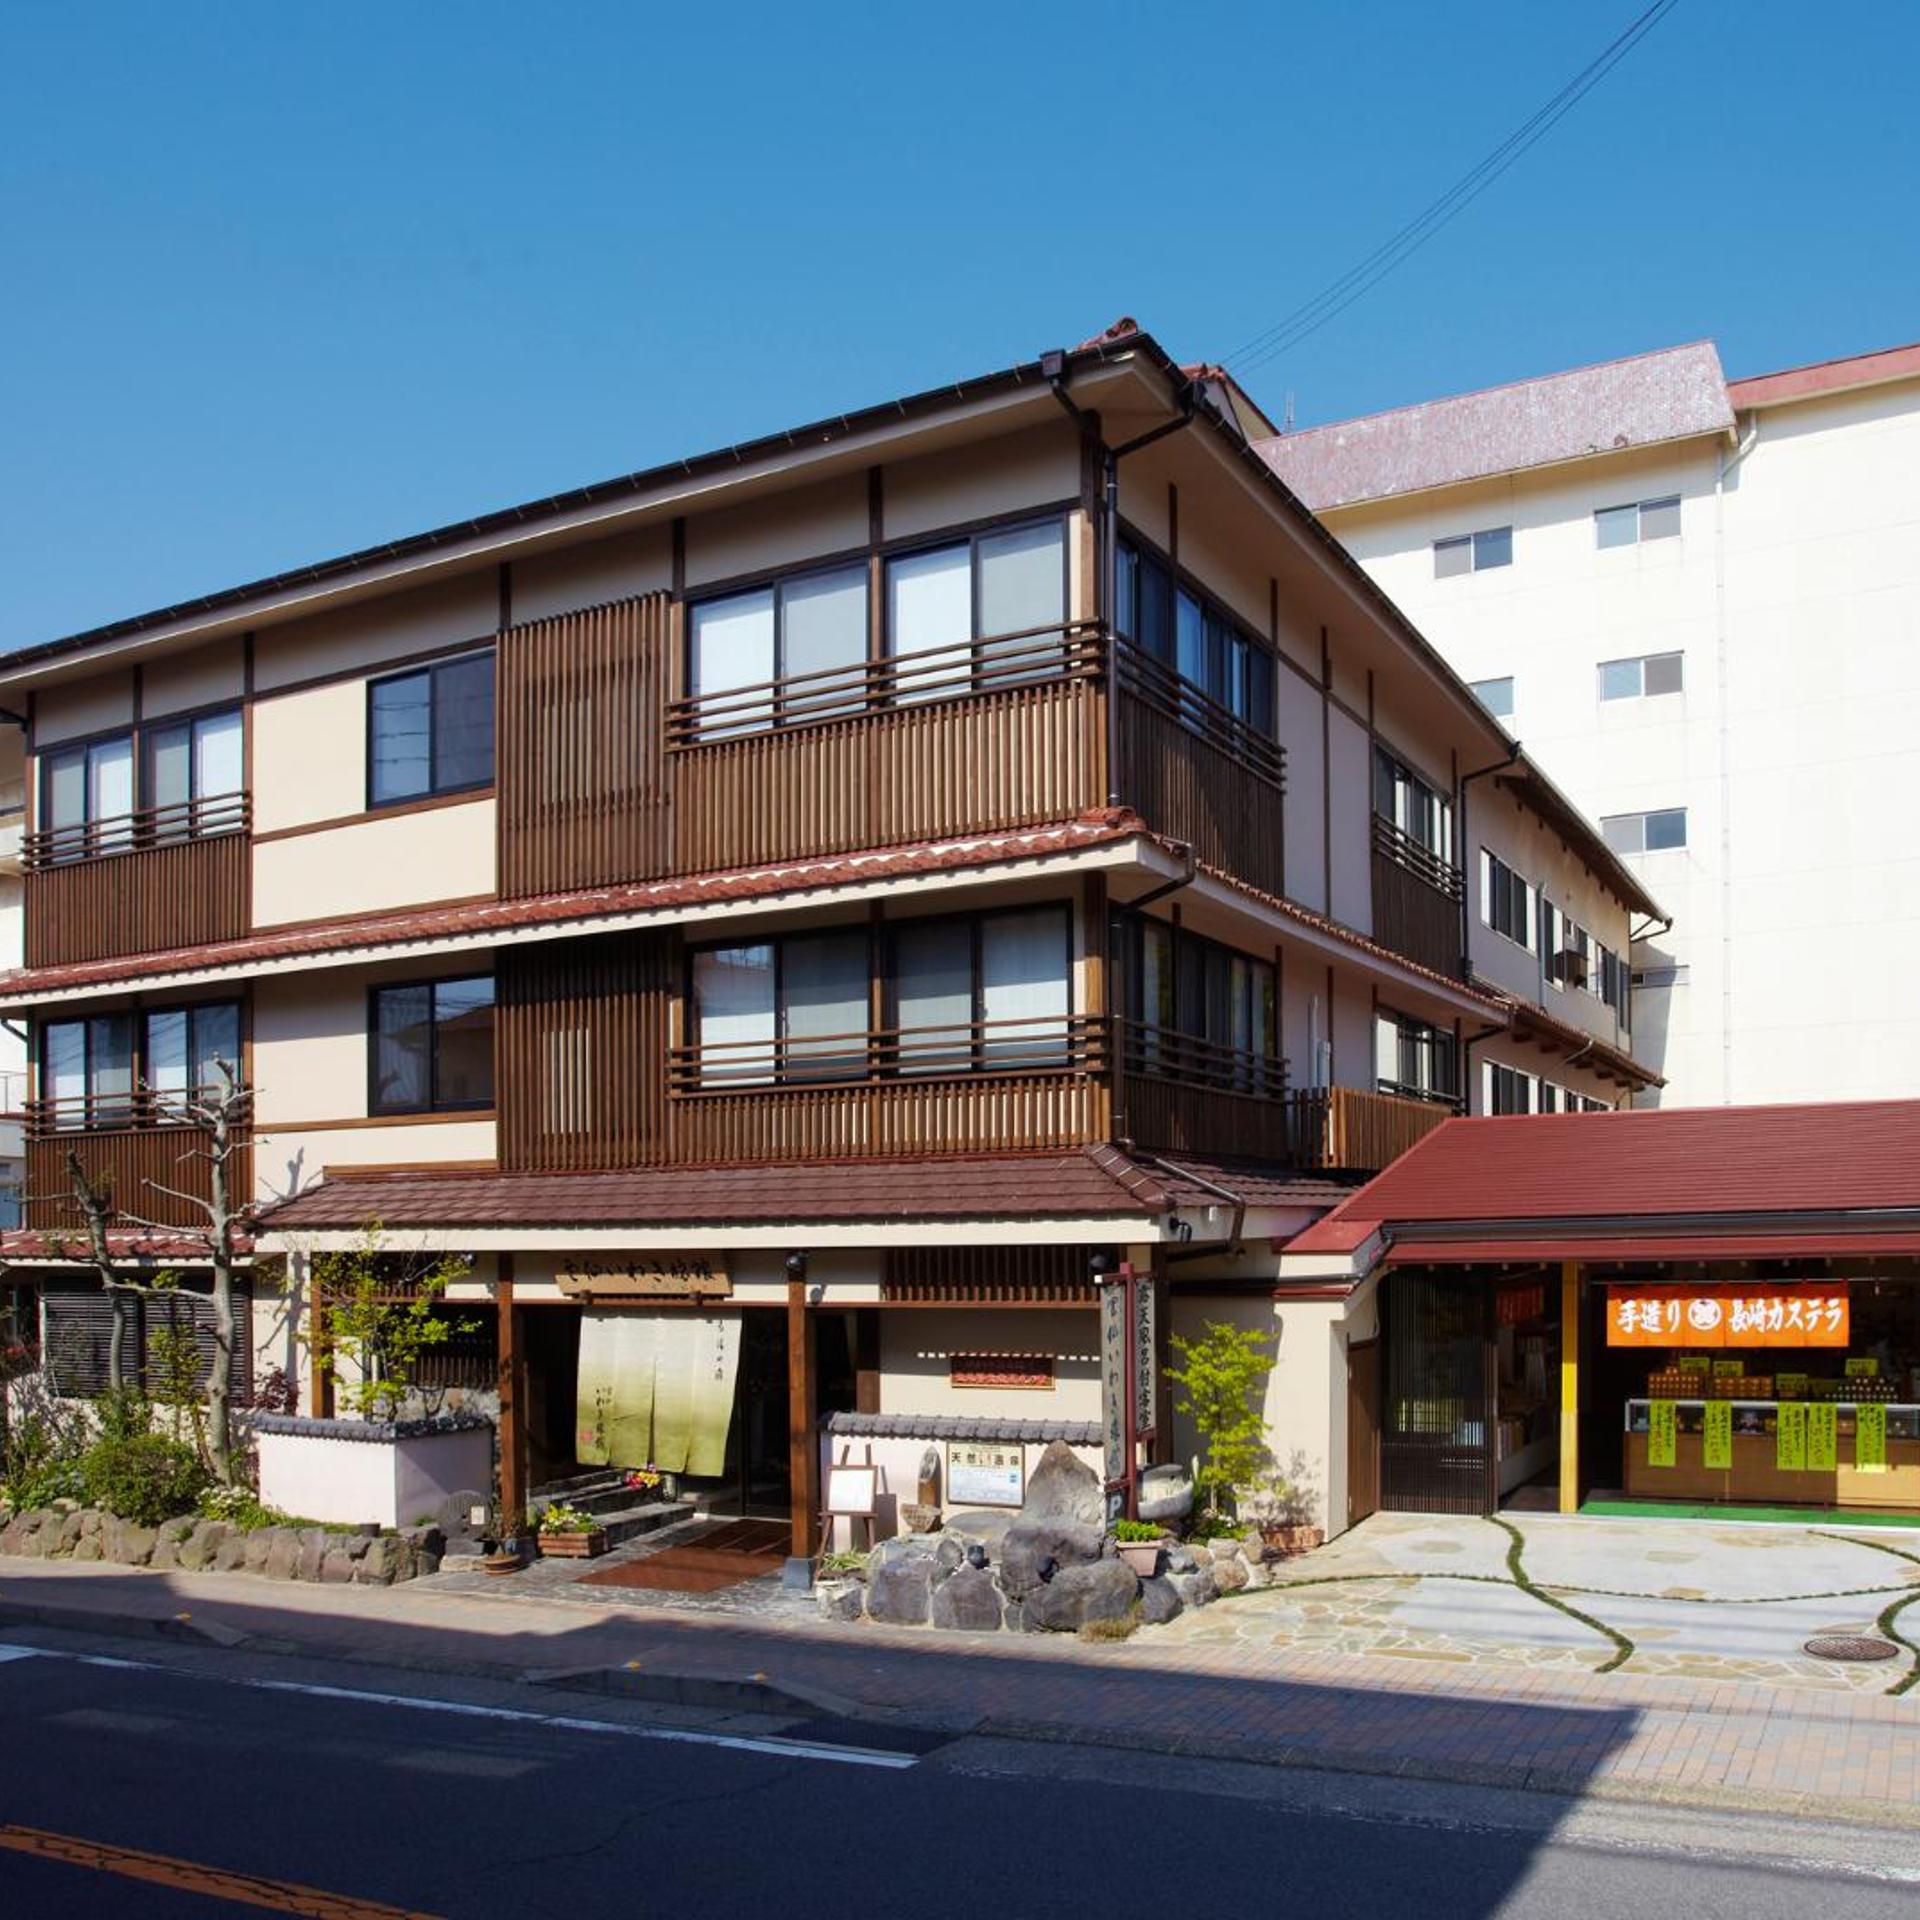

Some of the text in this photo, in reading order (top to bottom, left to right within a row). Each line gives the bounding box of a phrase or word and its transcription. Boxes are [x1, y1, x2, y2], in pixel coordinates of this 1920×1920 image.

[1617, 1298, 1843, 1334] 手造り 長崎カステラ
[1109, 1495, 1122, 1519] P
